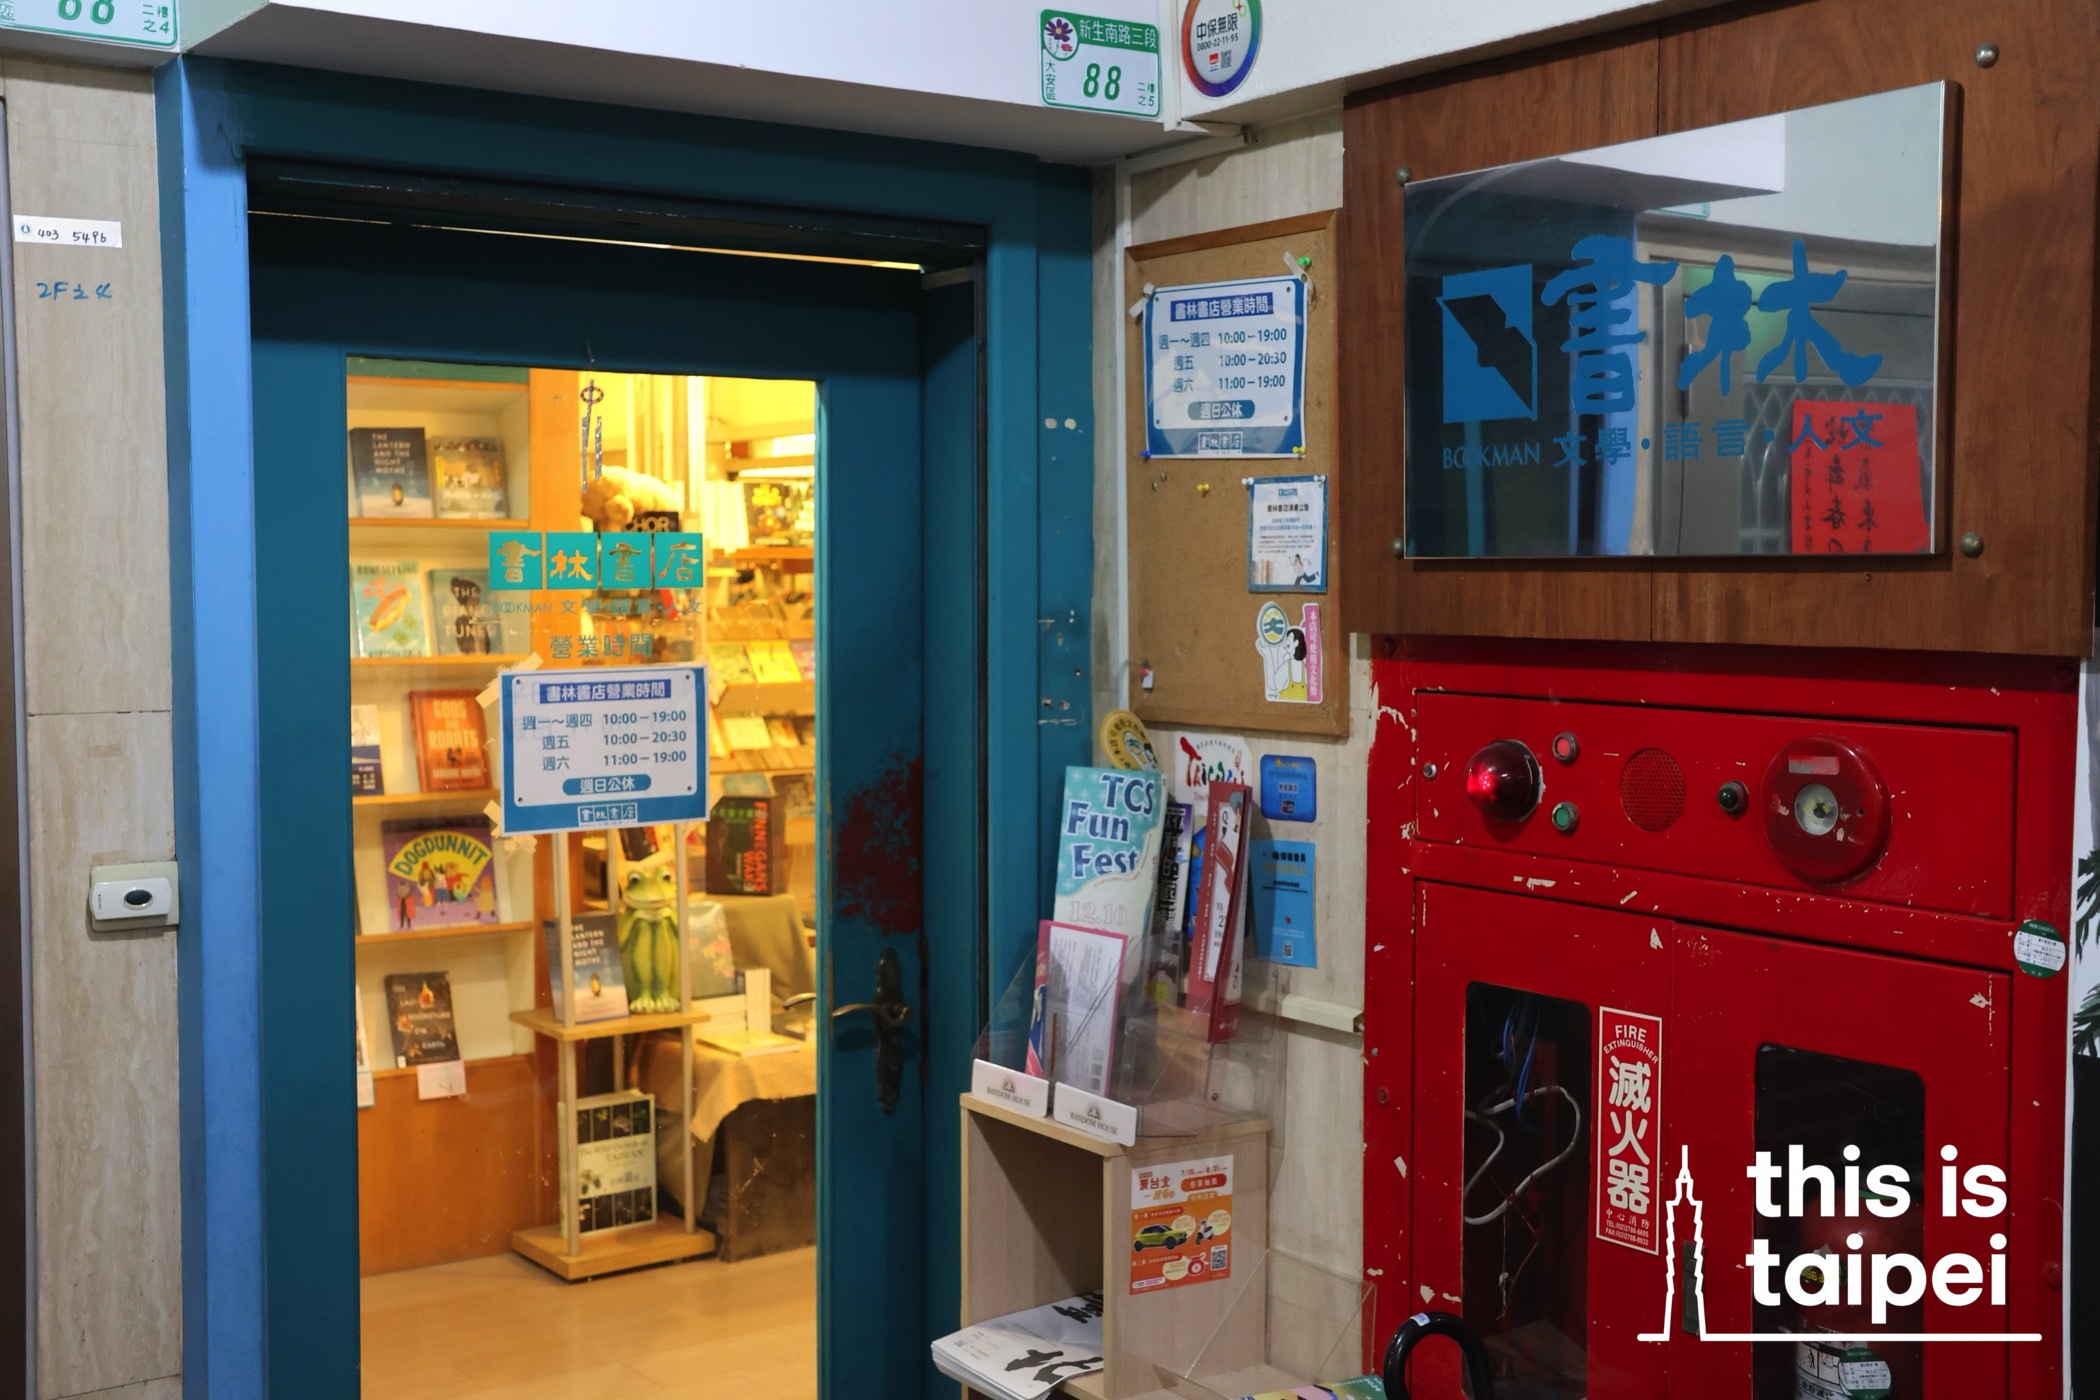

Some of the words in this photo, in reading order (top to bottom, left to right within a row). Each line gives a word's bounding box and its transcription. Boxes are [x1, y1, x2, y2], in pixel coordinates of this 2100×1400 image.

[1079, 18, 1157, 49] 新生南路三段
[1197, 12, 1238, 40] 中保無限
[1045, 62, 1056, 100] 大安區
[1083, 63, 1122, 100] 88
[38, 229, 59, 240] 403
[1174, 295, 1269, 320] 書林書店營業時間
[1540, 234, 1884, 414] 書林
[1173, 355, 1194, 371] 週五
[1173, 377, 1194, 393] 週六
[1200, 402, 1243, 419] 週日公休
[1442, 442, 1540, 469] BOOKMAN
[496, 538, 701, 583] 書林書店
[550, 633, 652, 660] 營業時間
[546, 681, 666, 702] 書林書店營業時間
[542, 735, 570, 750] 週五
[542, 756, 570, 772] 週六
[580, 776, 635, 794] 週日公休
[1102, 774, 1154, 815] TCS
[1066, 802, 1130, 842] Fun
[394, 834, 488, 876] DOGDUNNIT
[1073, 844, 1138, 878] Fest
[1069, 900, 1127, 926] 12.10
[1614, 1024, 1647, 1043] FIRE
[1604, 1038, 1658, 1064] EXTINGUISHER
[986, 1086, 1010, 1101] RANDOM
[1012, 1094, 1031, 1108] HOUSE
[1070, 1112, 1096, 1129] RANDOM
[1097, 1122, 1118, 1136] HOUSE
[1607, 1055, 1652, 1214] 滅火器
[1606, 1208, 1650, 1229] 中心消防
